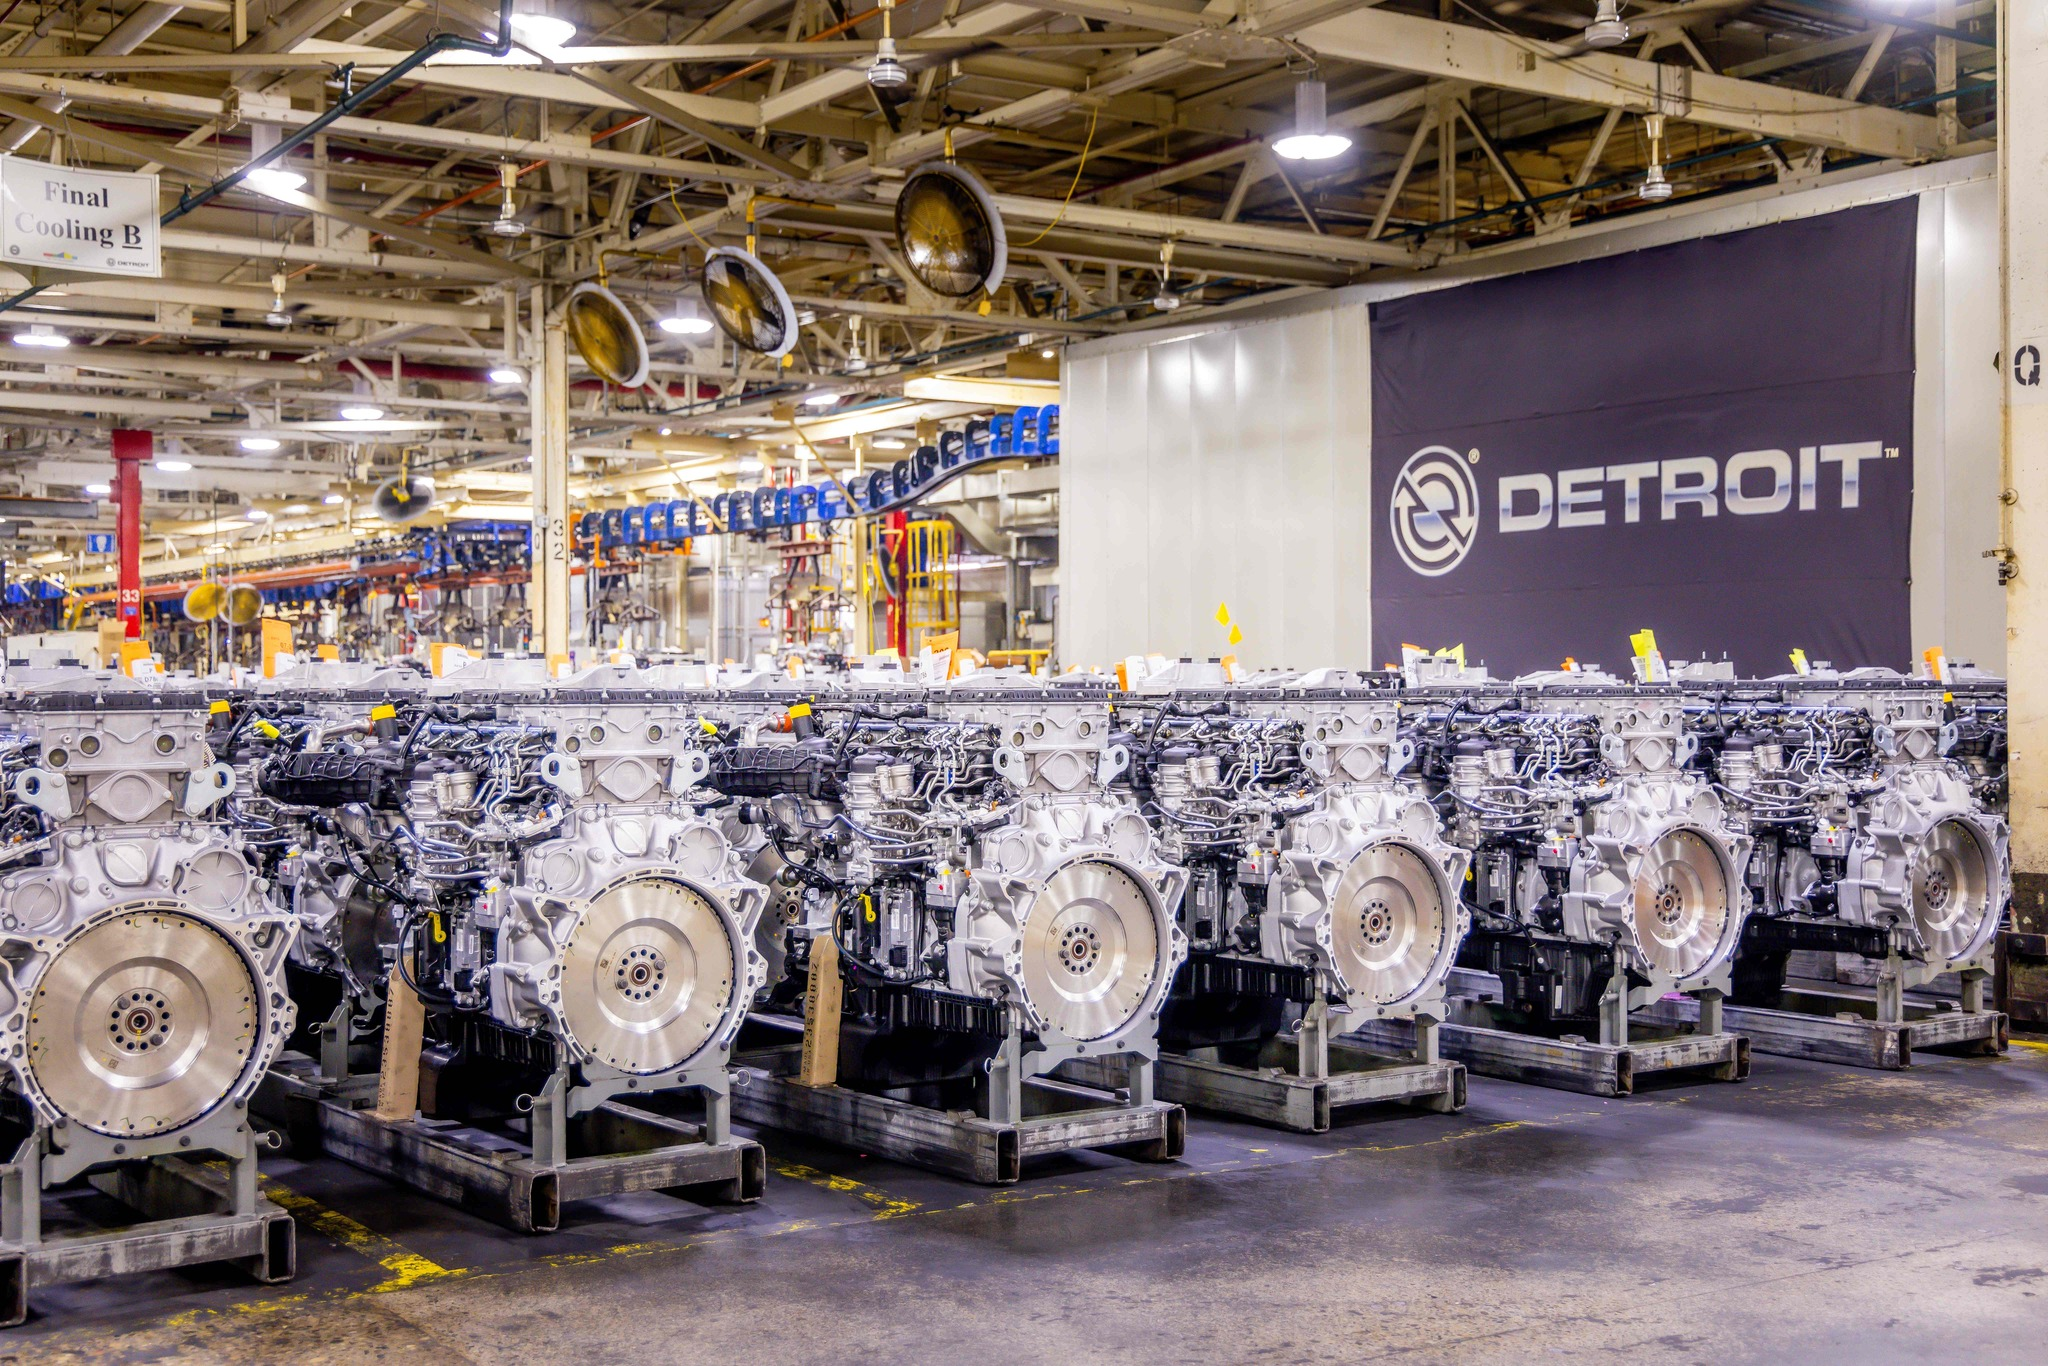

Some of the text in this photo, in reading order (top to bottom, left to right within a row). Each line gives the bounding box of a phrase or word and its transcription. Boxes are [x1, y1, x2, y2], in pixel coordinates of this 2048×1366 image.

[44, 180, 109, 208] Final
[14, 211, 142, 249] Cooling B
[118, 260, 149, 268] DETROIT
[2014, 345, 2041, 386] Q
[1499, 440, 1882, 533] DETROIT
[122, 589, 140, 603] 33
